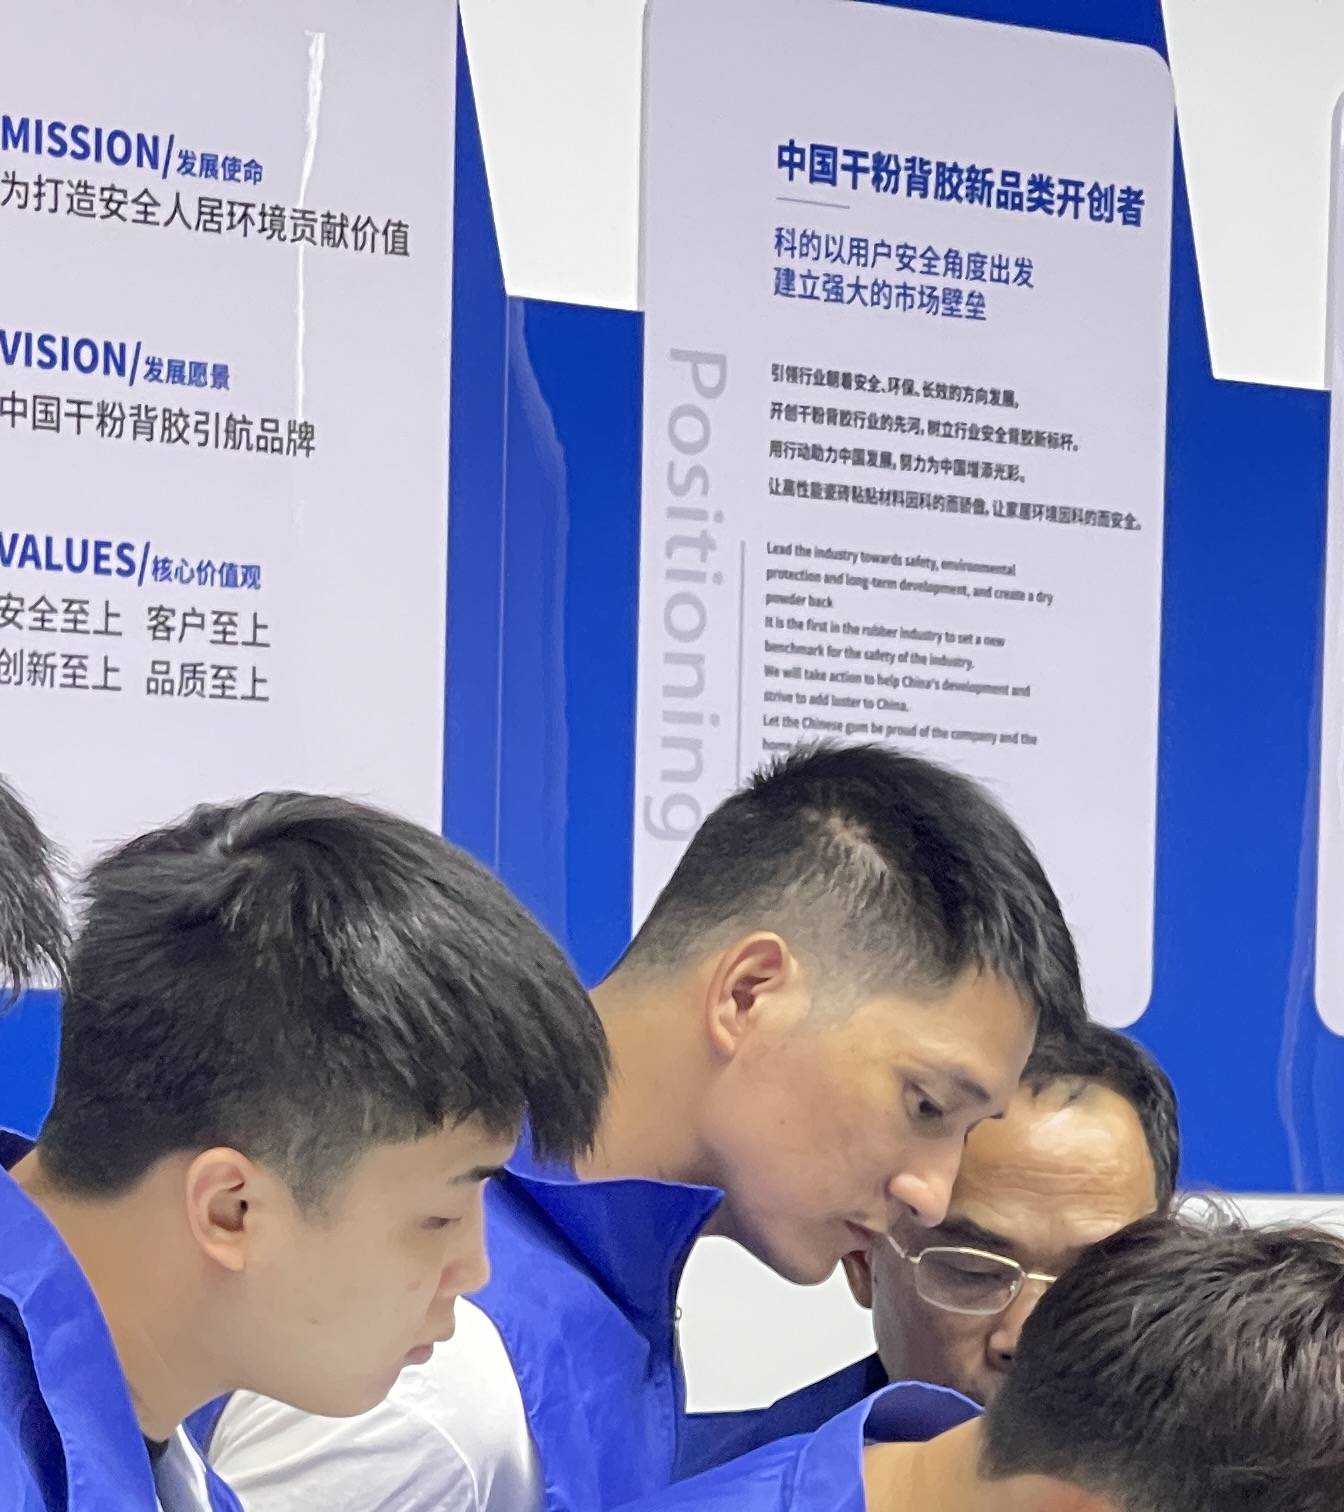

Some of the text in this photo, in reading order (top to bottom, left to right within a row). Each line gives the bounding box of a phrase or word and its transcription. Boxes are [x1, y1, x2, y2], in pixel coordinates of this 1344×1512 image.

[0, 114, 264, 186] MISSION/发展使命
[776, 139, 1145, 228] 中国干粉背胶新品类开创者
[0, 169, 412, 258] 为打造安全人居环境贡献价值
[774, 226, 1034, 289] 科的以用户安全角度出发
[773, 266, 987, 323] 建立强大的市场壁垒
[146, 605, 271, 650] 客户至上
[643, 347, 727, 841] Positioning
[145, 661, 270, 704] 品质至上
